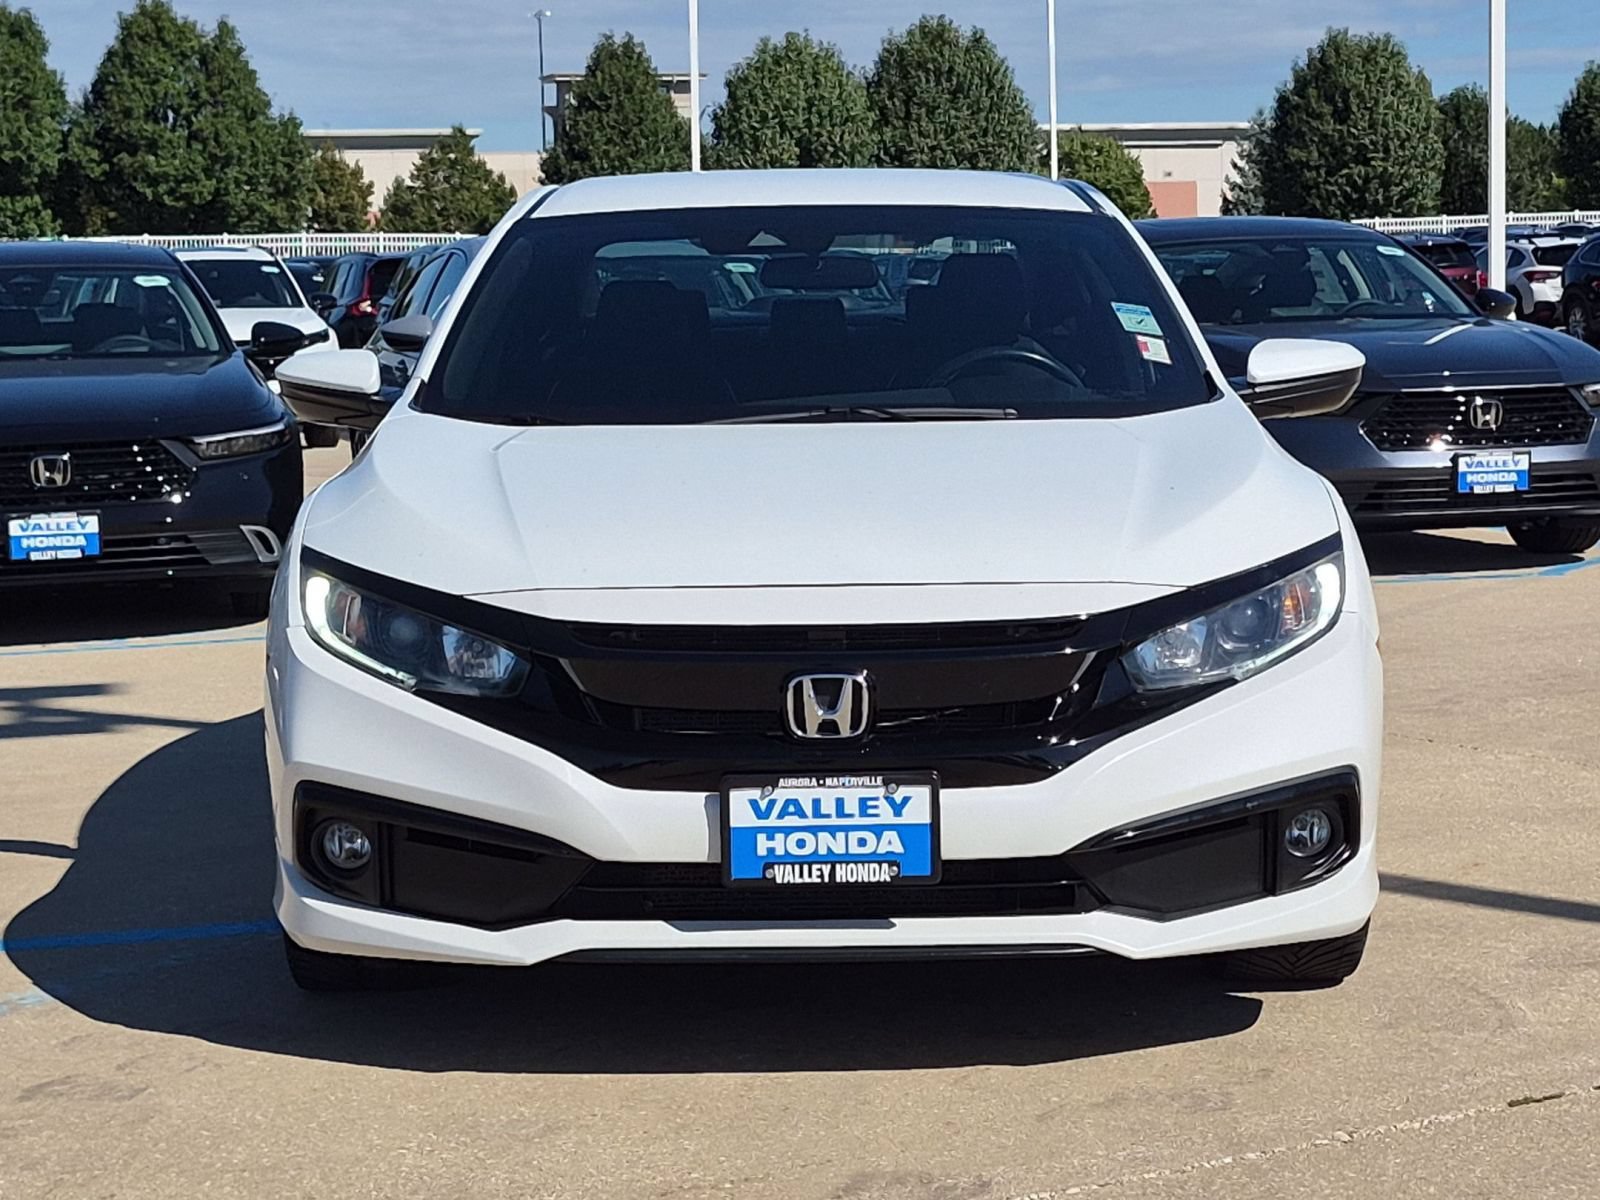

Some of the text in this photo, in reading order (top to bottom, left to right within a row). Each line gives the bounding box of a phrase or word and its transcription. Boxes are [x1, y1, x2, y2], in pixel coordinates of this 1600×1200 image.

[1465, 458, 1520, 469] VALLEY
[1466, 471, 1518, 483] HONDA
[18, 520, 89, 532] VALLEY
[21, 535, 87, 549] HONDA
[778, 777, 818, 787] AURORA
[747, 795, 913, 820] VALLEY
[756, 830, 905, 856] HONDA
[773, 863, 892, 884] VALLEY HONDA
